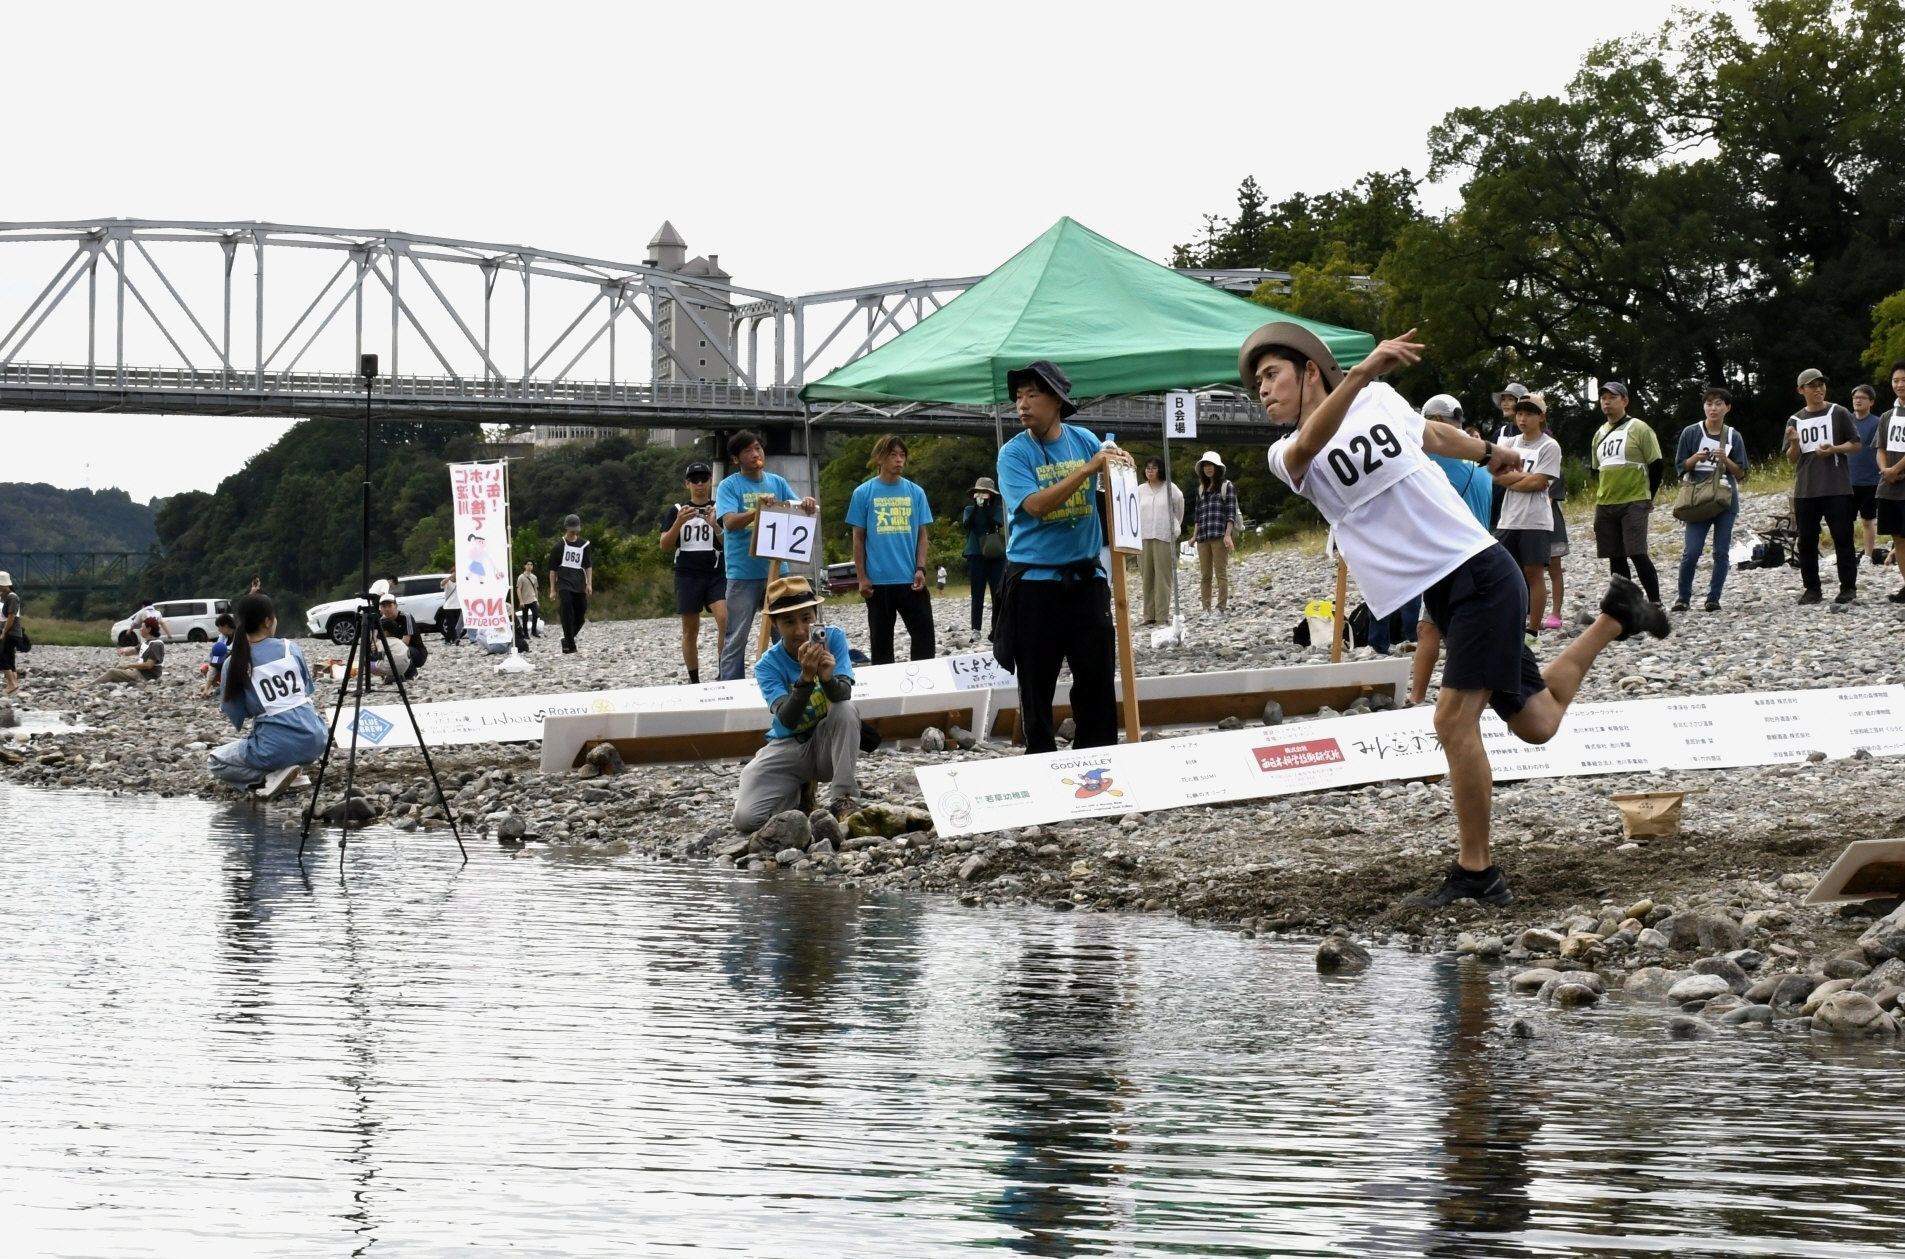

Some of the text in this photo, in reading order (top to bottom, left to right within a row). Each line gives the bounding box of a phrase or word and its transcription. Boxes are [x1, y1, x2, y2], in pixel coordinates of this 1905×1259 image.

[1174, 397, 1186, 434] B会場
[1801, 424, 1828, 444] 001
[1327, 423, 1402, 487] 029
[1602, 438, 1624, 457] 107
[1116, 489, 1139, 538] 10
[683, 524, 711, 542] 018
[765, 521, 809, 555] 12
[565, 551, 581, 564] 063
[259, 669, 301, 702] 092
[359, 717, 379, 727] BLUE
[480, 711, 532, 726] Lisboa
